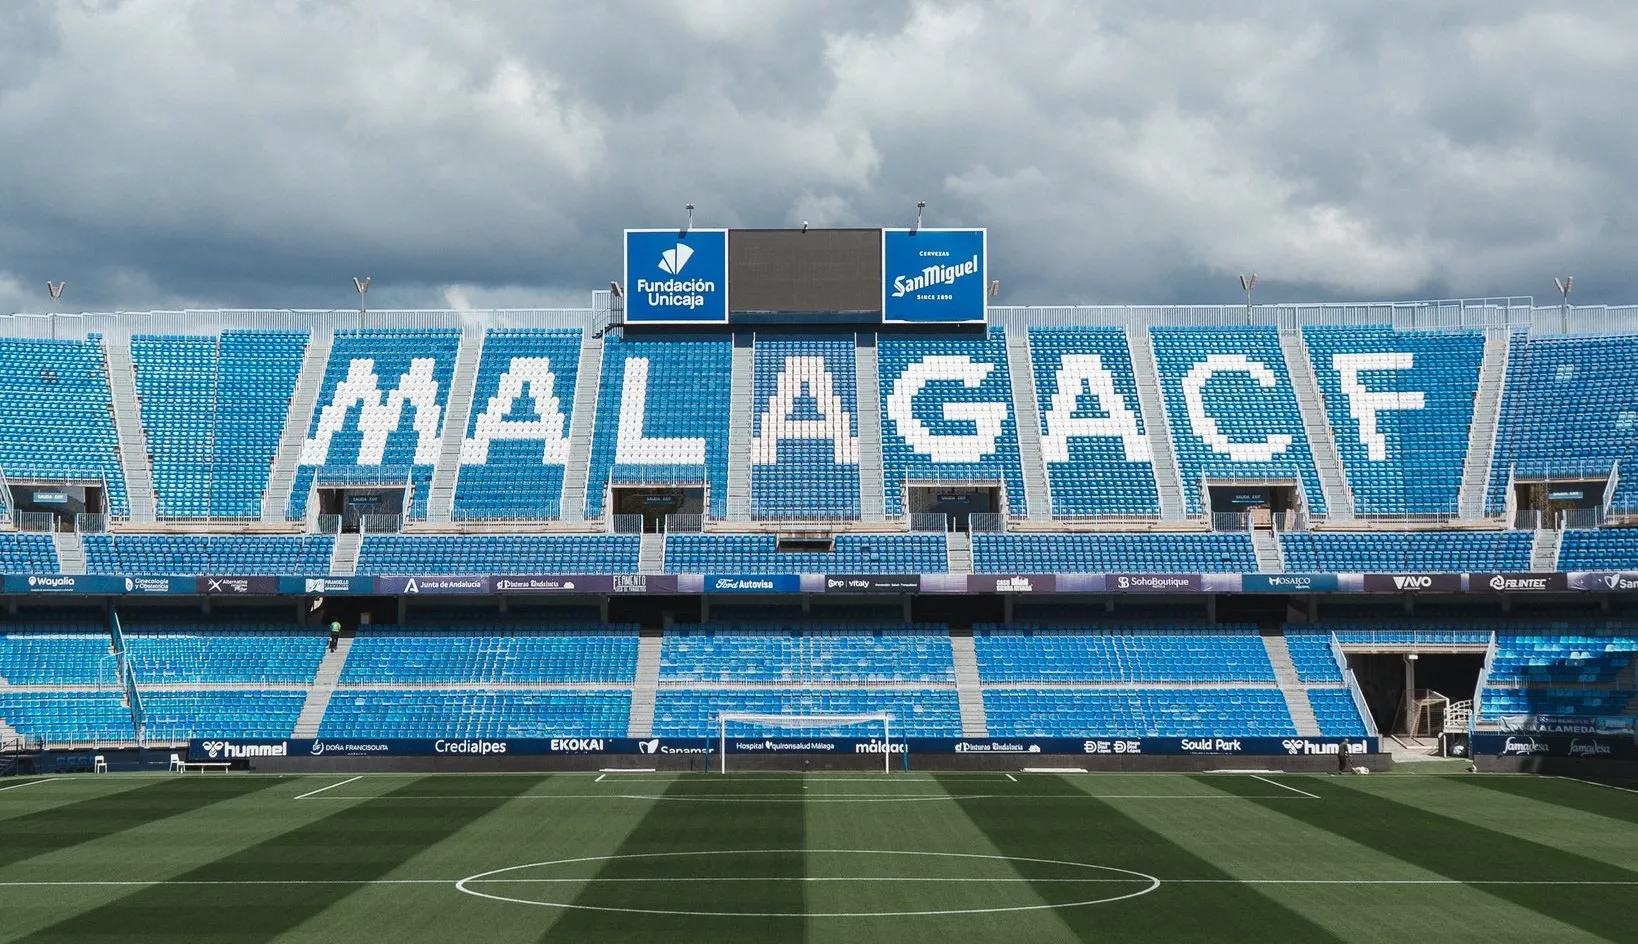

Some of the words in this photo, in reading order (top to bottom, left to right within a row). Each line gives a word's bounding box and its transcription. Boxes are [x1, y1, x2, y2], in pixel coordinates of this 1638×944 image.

[637, 278, 715, 292] Fundación
[648, 292, 704, 310] Unicaja
[37, 577, 75, 587] Wayalia
[715, 578, 740, 588] Ford
[739, 579, 773, 588] Autovisa
[848, 580, 870, 588] vitaly
[224, 741, 288, 757] hummel
[435, 739, 507, 755] Credialpes
[550, 739, 604, 750] EKOKAI
[736, 742, 764, 751] Hospital
[811, 742, 835, 751] Málaga
[1181, 739, 1212, 750] Sould
[1215, 739, 1241, 750] Park
